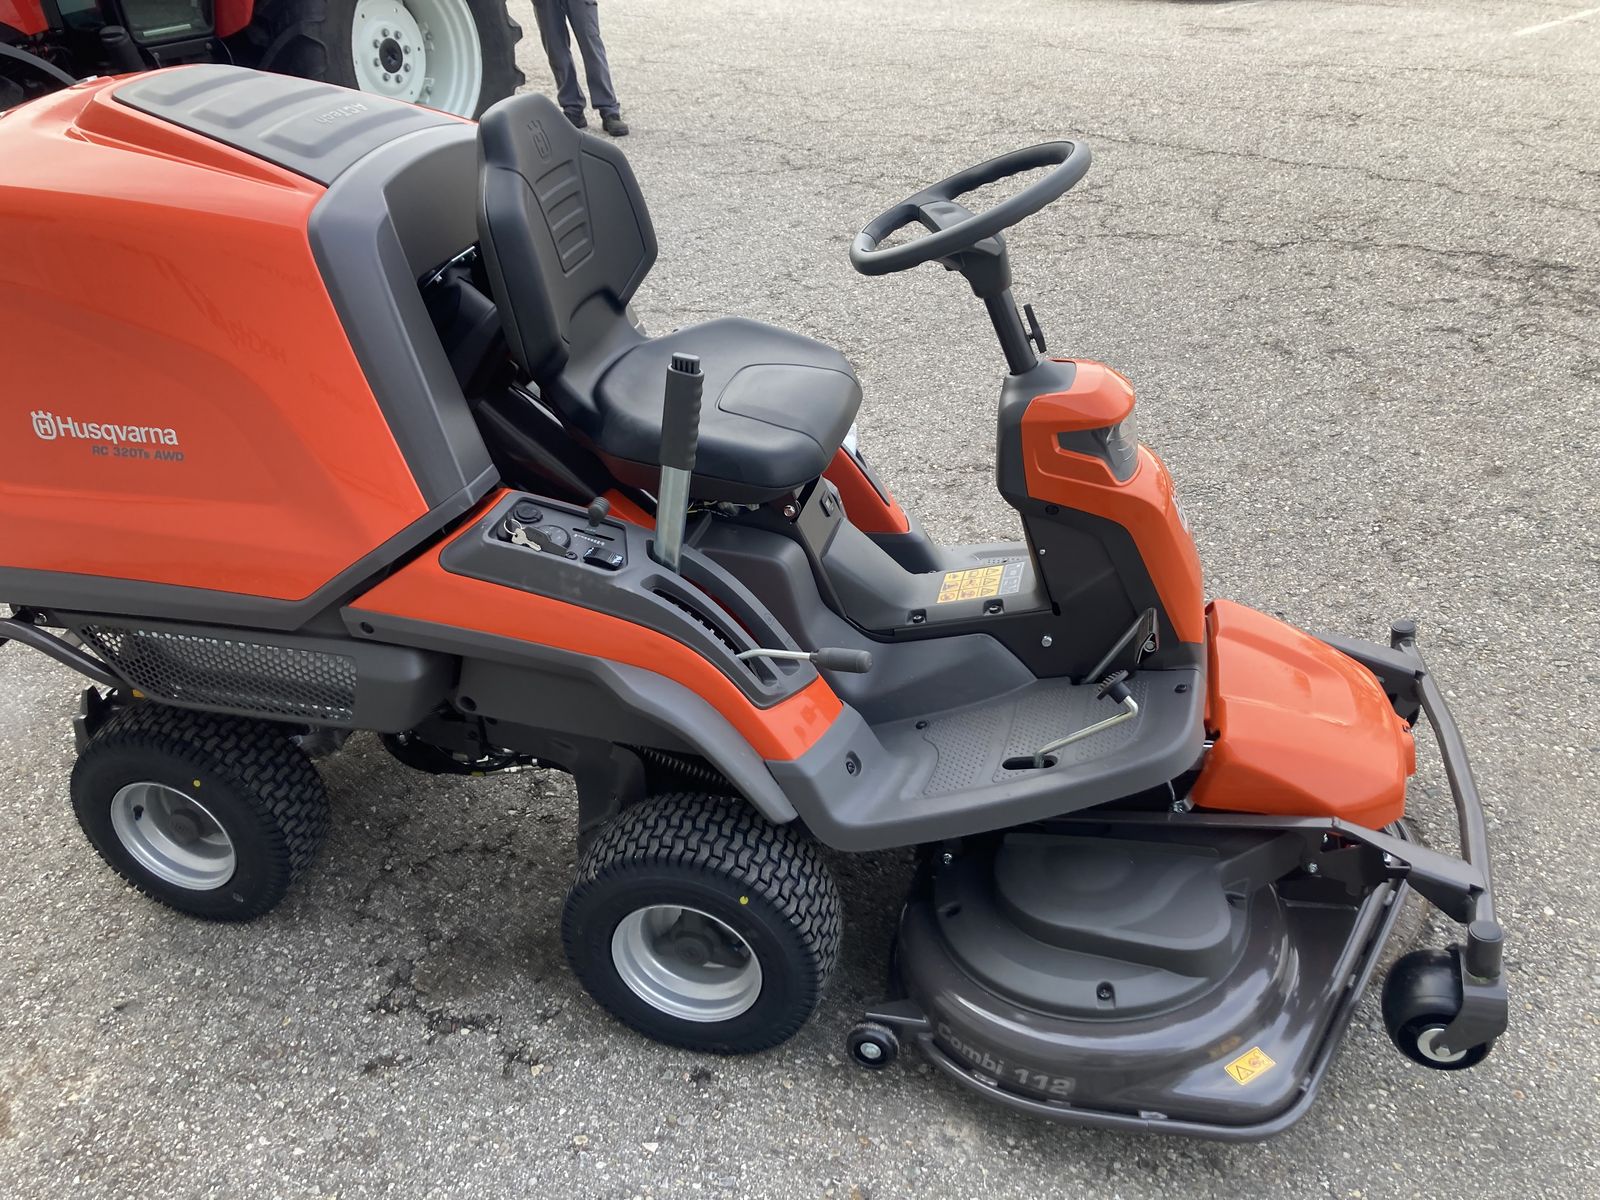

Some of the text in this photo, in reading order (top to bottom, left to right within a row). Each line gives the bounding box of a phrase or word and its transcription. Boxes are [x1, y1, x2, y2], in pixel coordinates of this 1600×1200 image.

[55, 415, 179, 446] Husqvarna
[92, 445, 109, 456] RC
[154, 450, 185, 462] AWD
[937, 1021, 1075, 1096] Combi 112
